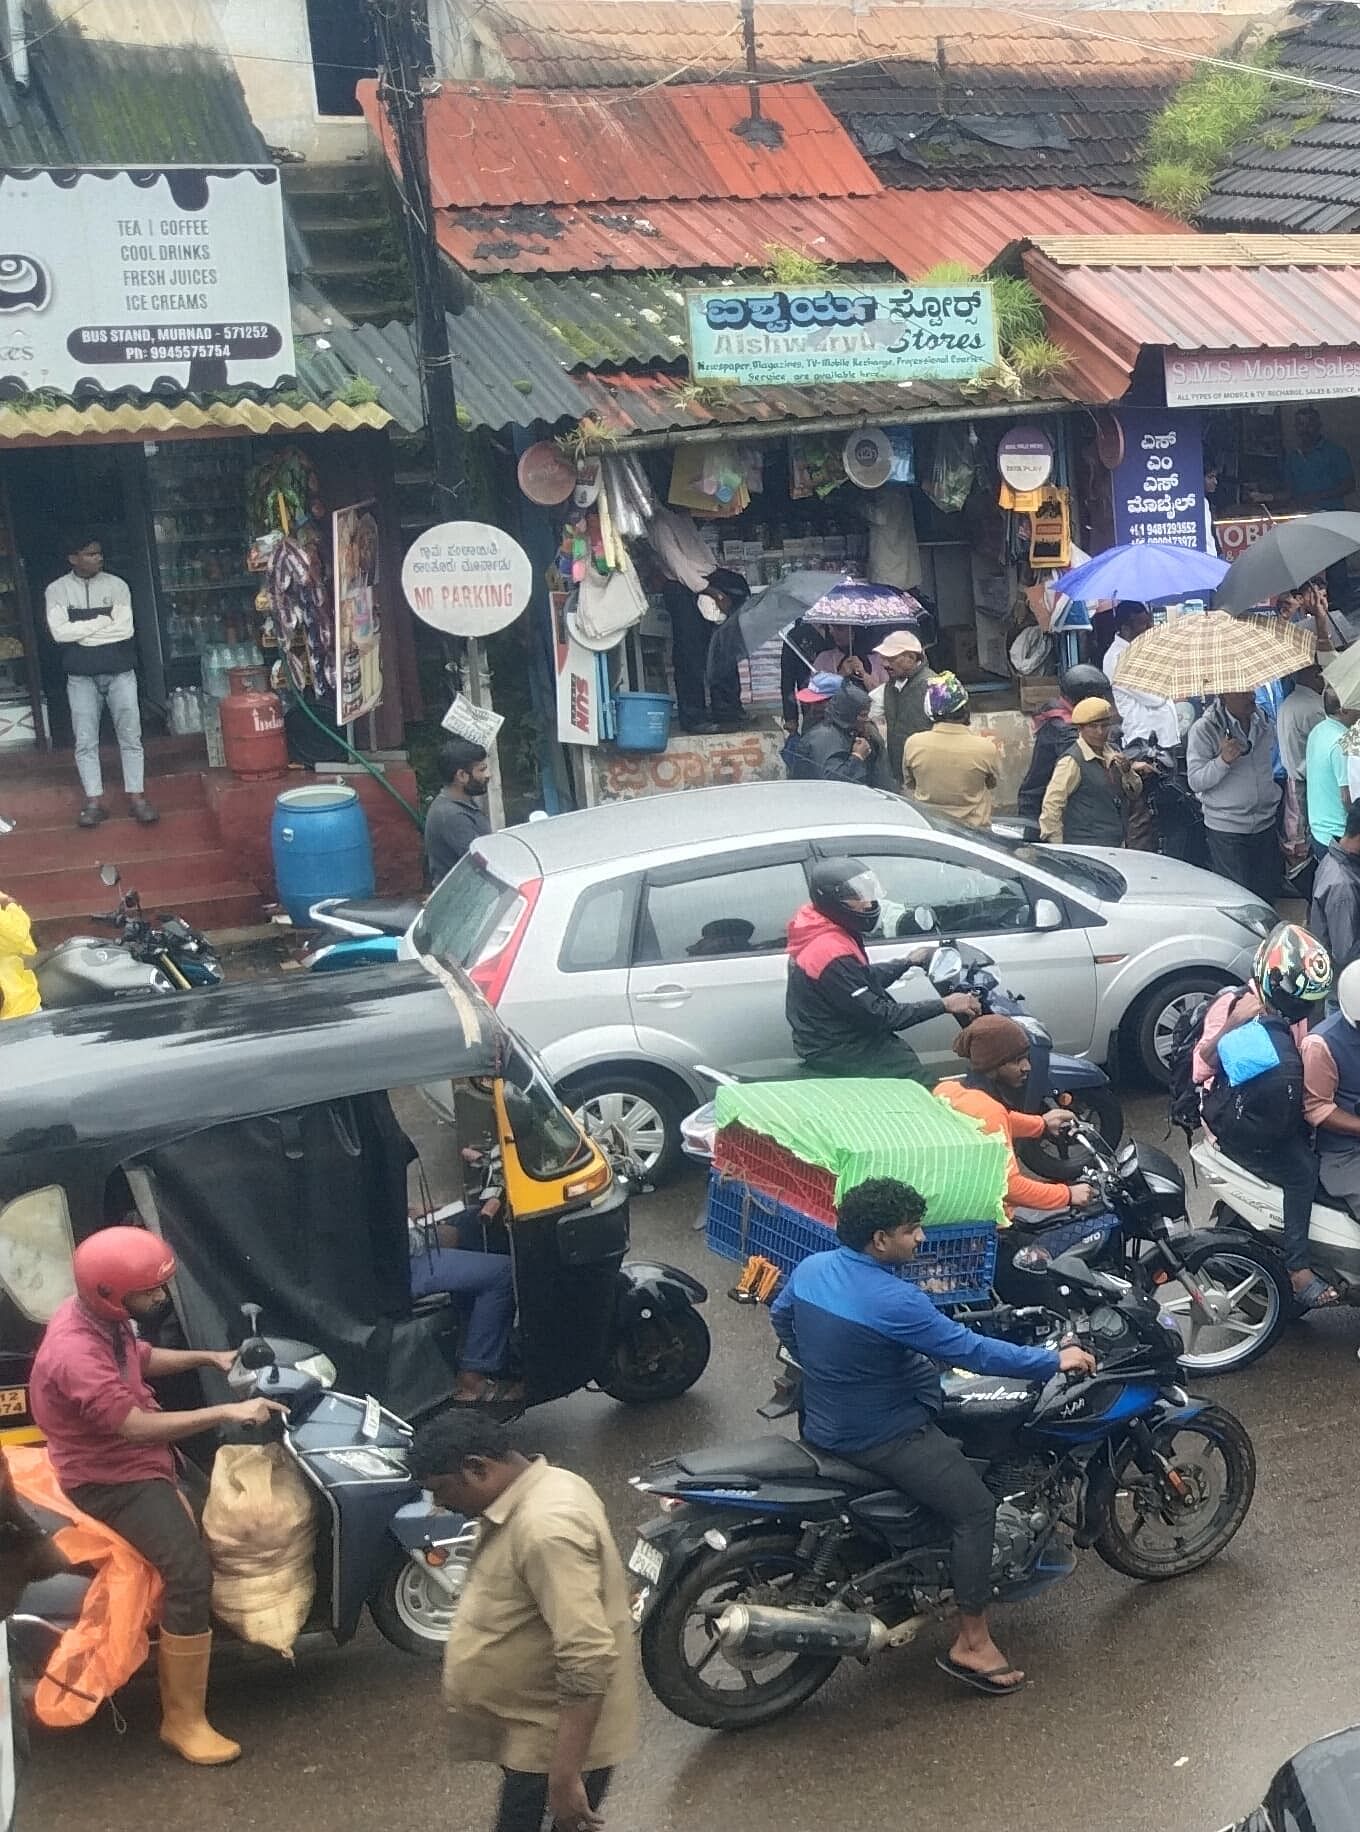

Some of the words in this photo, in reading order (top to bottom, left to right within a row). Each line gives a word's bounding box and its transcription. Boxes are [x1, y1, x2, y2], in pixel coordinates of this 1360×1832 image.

[117, 219, 142, 237] TEA
[160, 219, 209, 237] COFFEE
[120, 244, 156, 262] COOL
[159, 244, 211, 262] DRINKS
[123, 269, 166, 287] FRESH
[169, 268, 218, 286] JUICES
[125, 294, 150, 311] ICE
[151, 293, 209, 311] CREAMS
[705, 290, 878, 332] ಐಶ್ವರ್ಯ
[888, 289, 982, 326] ಸ್ಟೋರ್ಸ್
[81, 329, 107, 344] BUS
[110, 328, 156, 346] STAND,
[157, 327, 213, 343] MURNAD
[223, 325, 269, 339] 571252
[887, 329, 986, 353] Stores
[150, 344, 232, 360] 9945575754
[748, 372, 787, 383] Service
[794, 372, 809, 381] are
[813, 371, 858, 382] available
[1242, 358, 1311, 383] Mobile
[1177, 392, 1190, 401] ALL
[1191, 392, 1212, 401] TYPES
[1256, 389, 1266, 399] TV
[1140, 431, 1178, 450] ಎಸ್
[1146, 455, 1173, 471] ಎಂ
[1143, 473, 1180, 492] ಎಸ್
[1127, 493, 1197, 520] ಮೊಬೈಲ್
[413, 586, 434, 611] NO
[440, 582, 513, 609] PARKING
[576, 677, 590, 733] SUN
